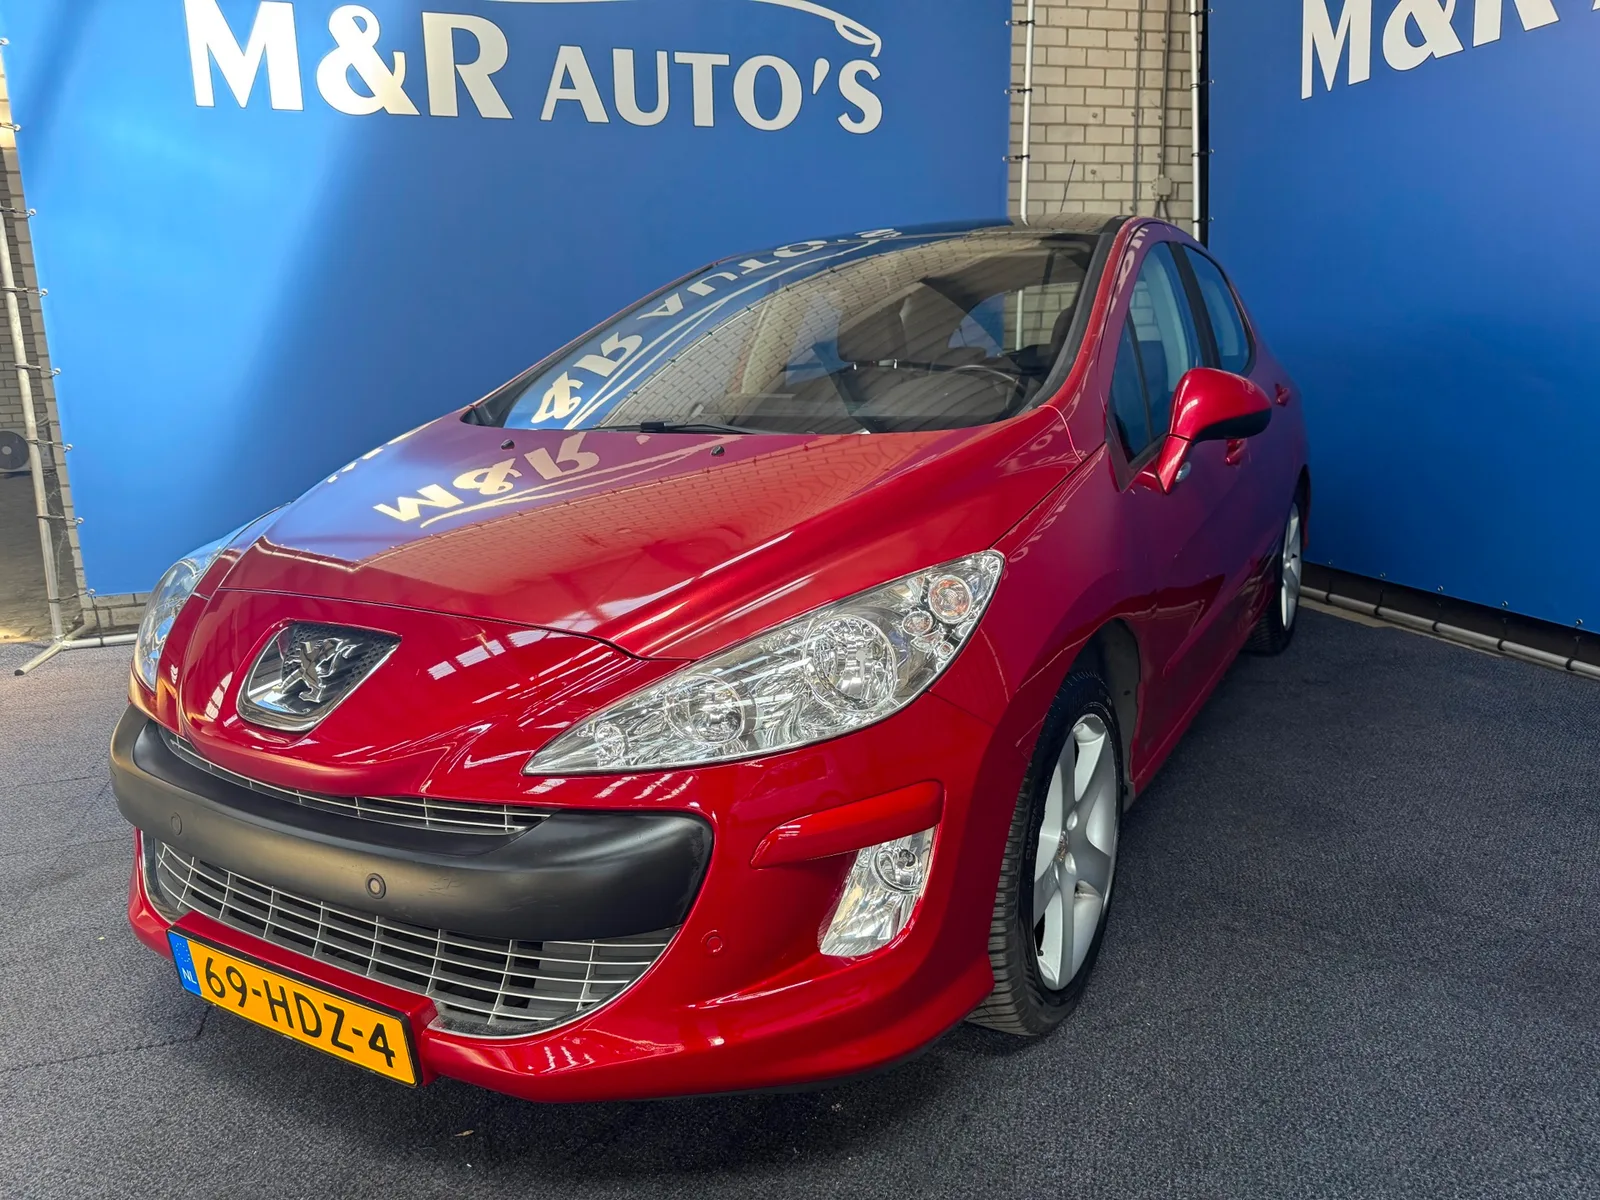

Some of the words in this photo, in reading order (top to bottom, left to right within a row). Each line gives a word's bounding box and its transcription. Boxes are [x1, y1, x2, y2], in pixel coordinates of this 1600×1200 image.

[183, 0, 514, 120] M&R
[540, 45, 883, 135] AUTO'S
[182, 968, 198, 985] NL
[204, 957, 396, 1068] 69-HDZ-4
